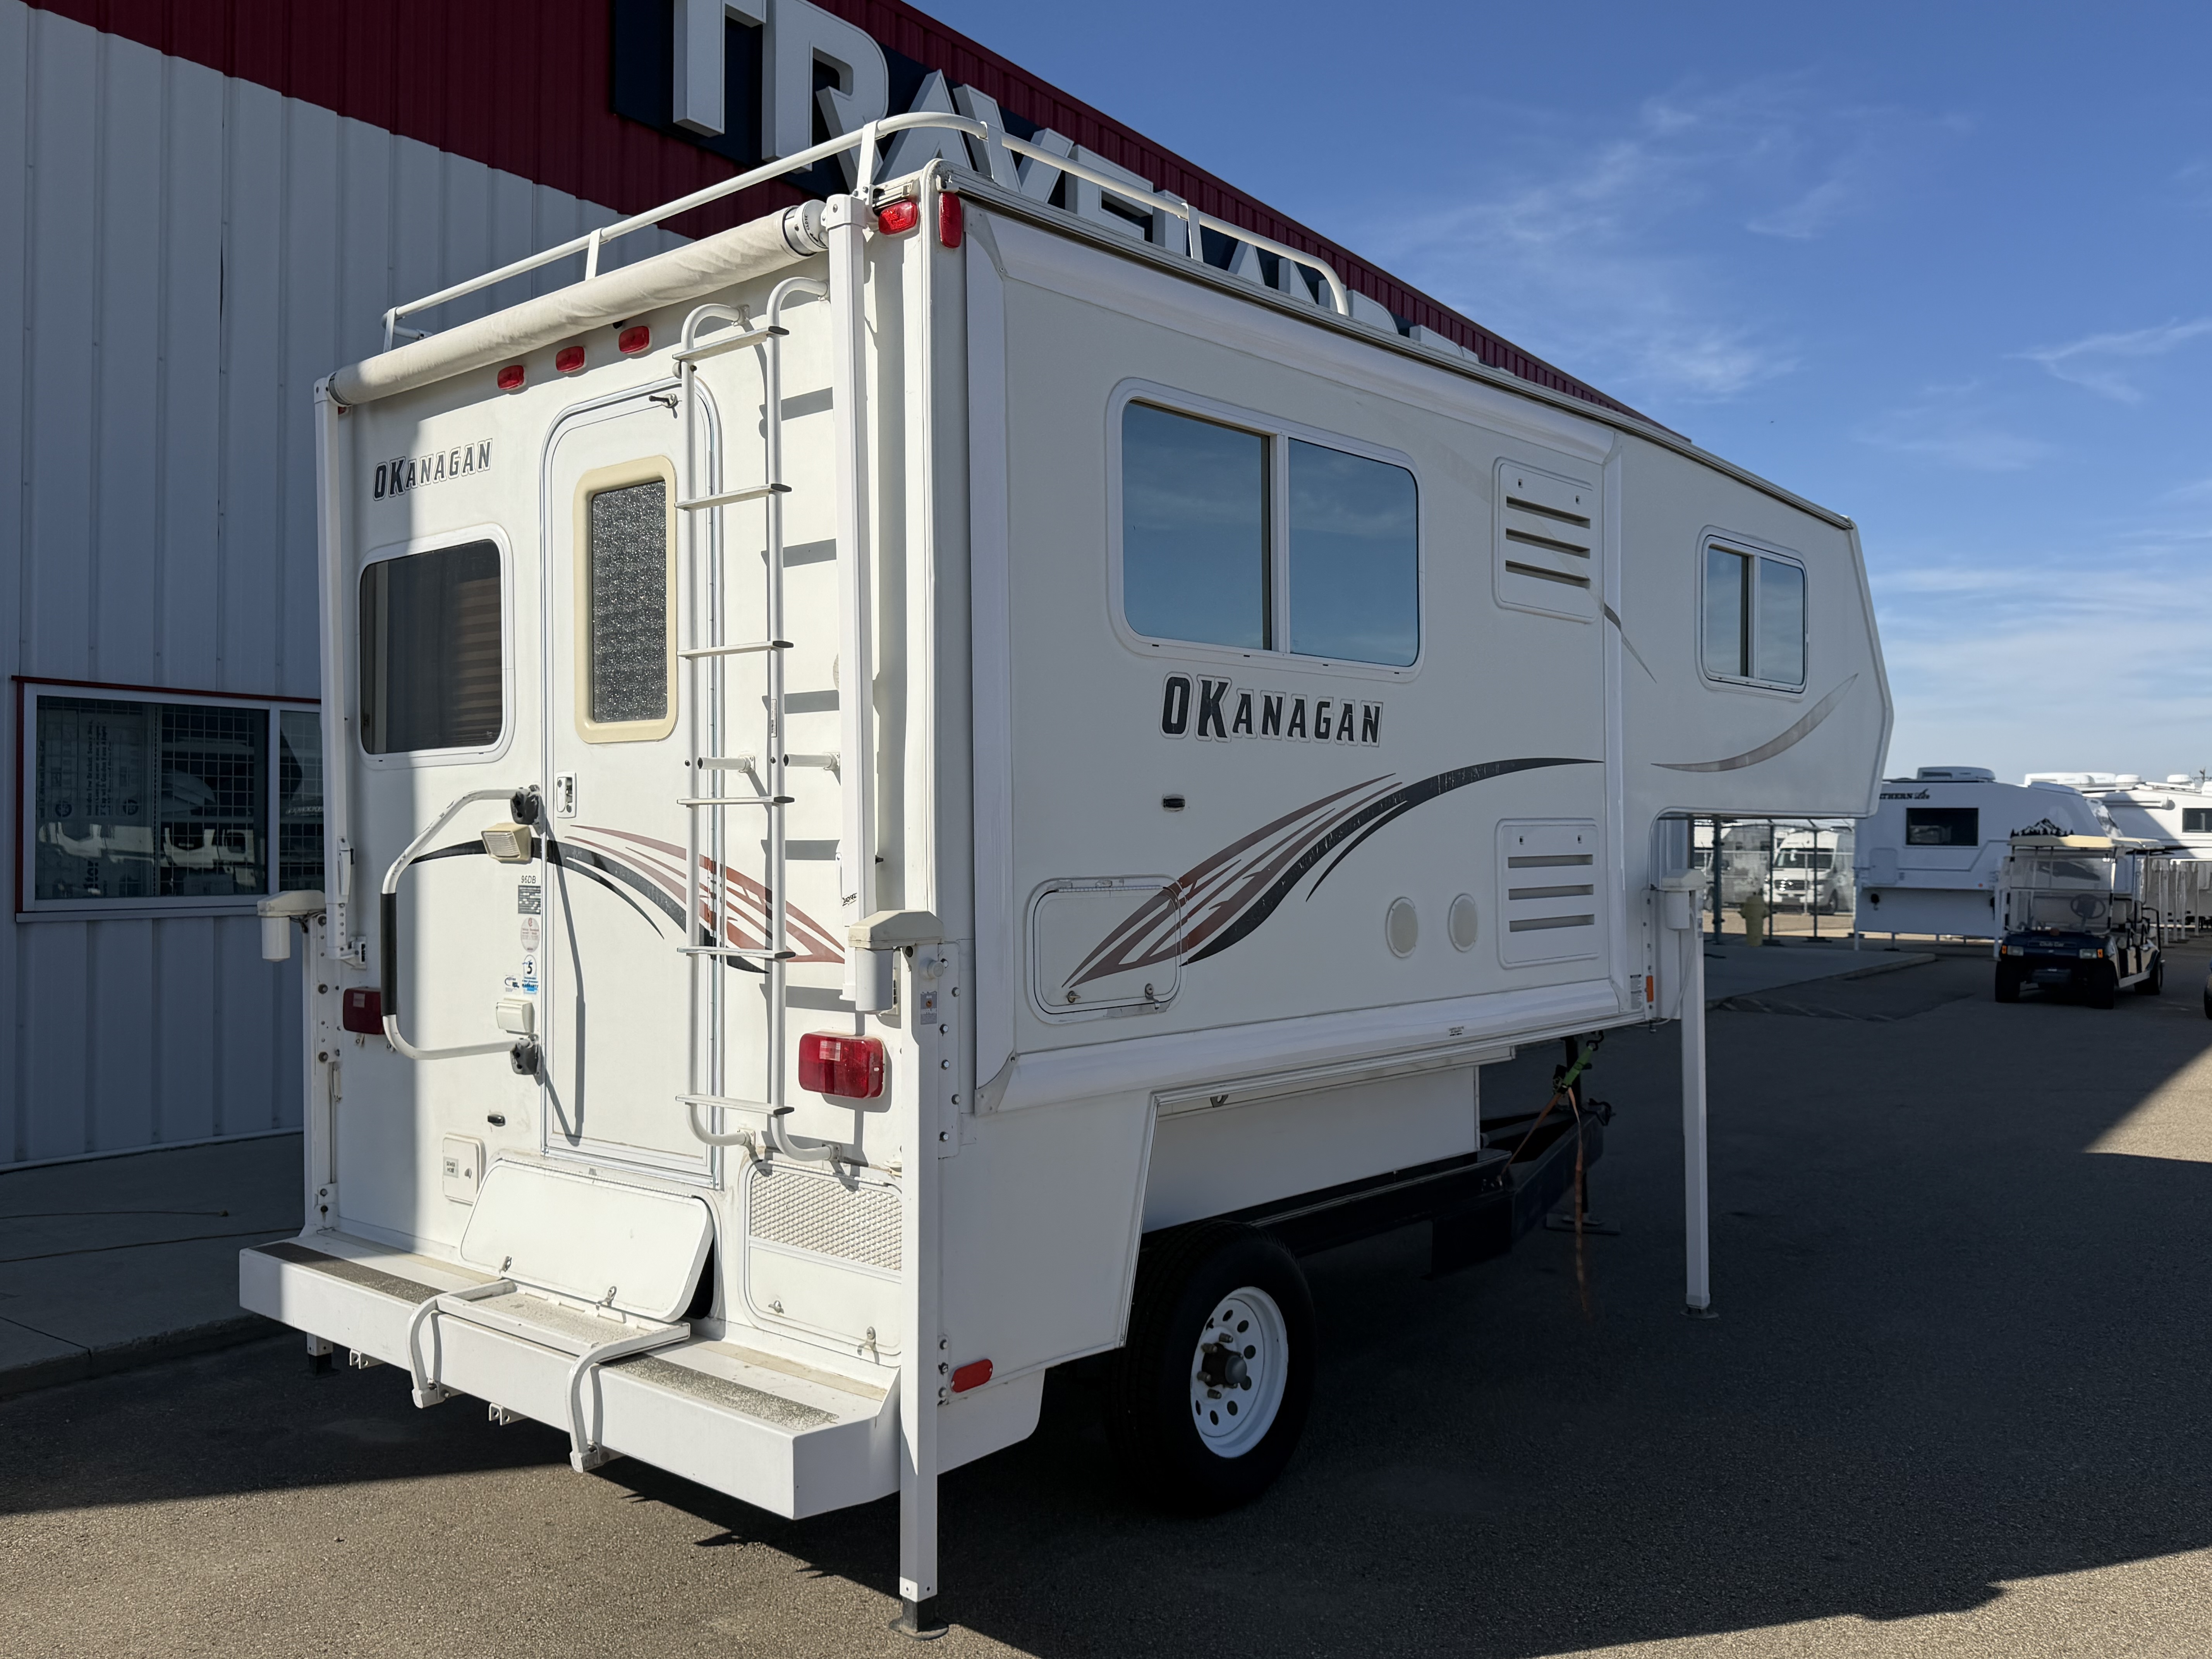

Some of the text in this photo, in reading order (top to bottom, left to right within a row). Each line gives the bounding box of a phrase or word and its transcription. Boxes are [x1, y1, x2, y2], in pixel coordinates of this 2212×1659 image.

[373, 438, 493, 501] OKANAGAN
[1159, 671, 1383, 747] OKANAGAN
[527, 962, 533, 974] 5
